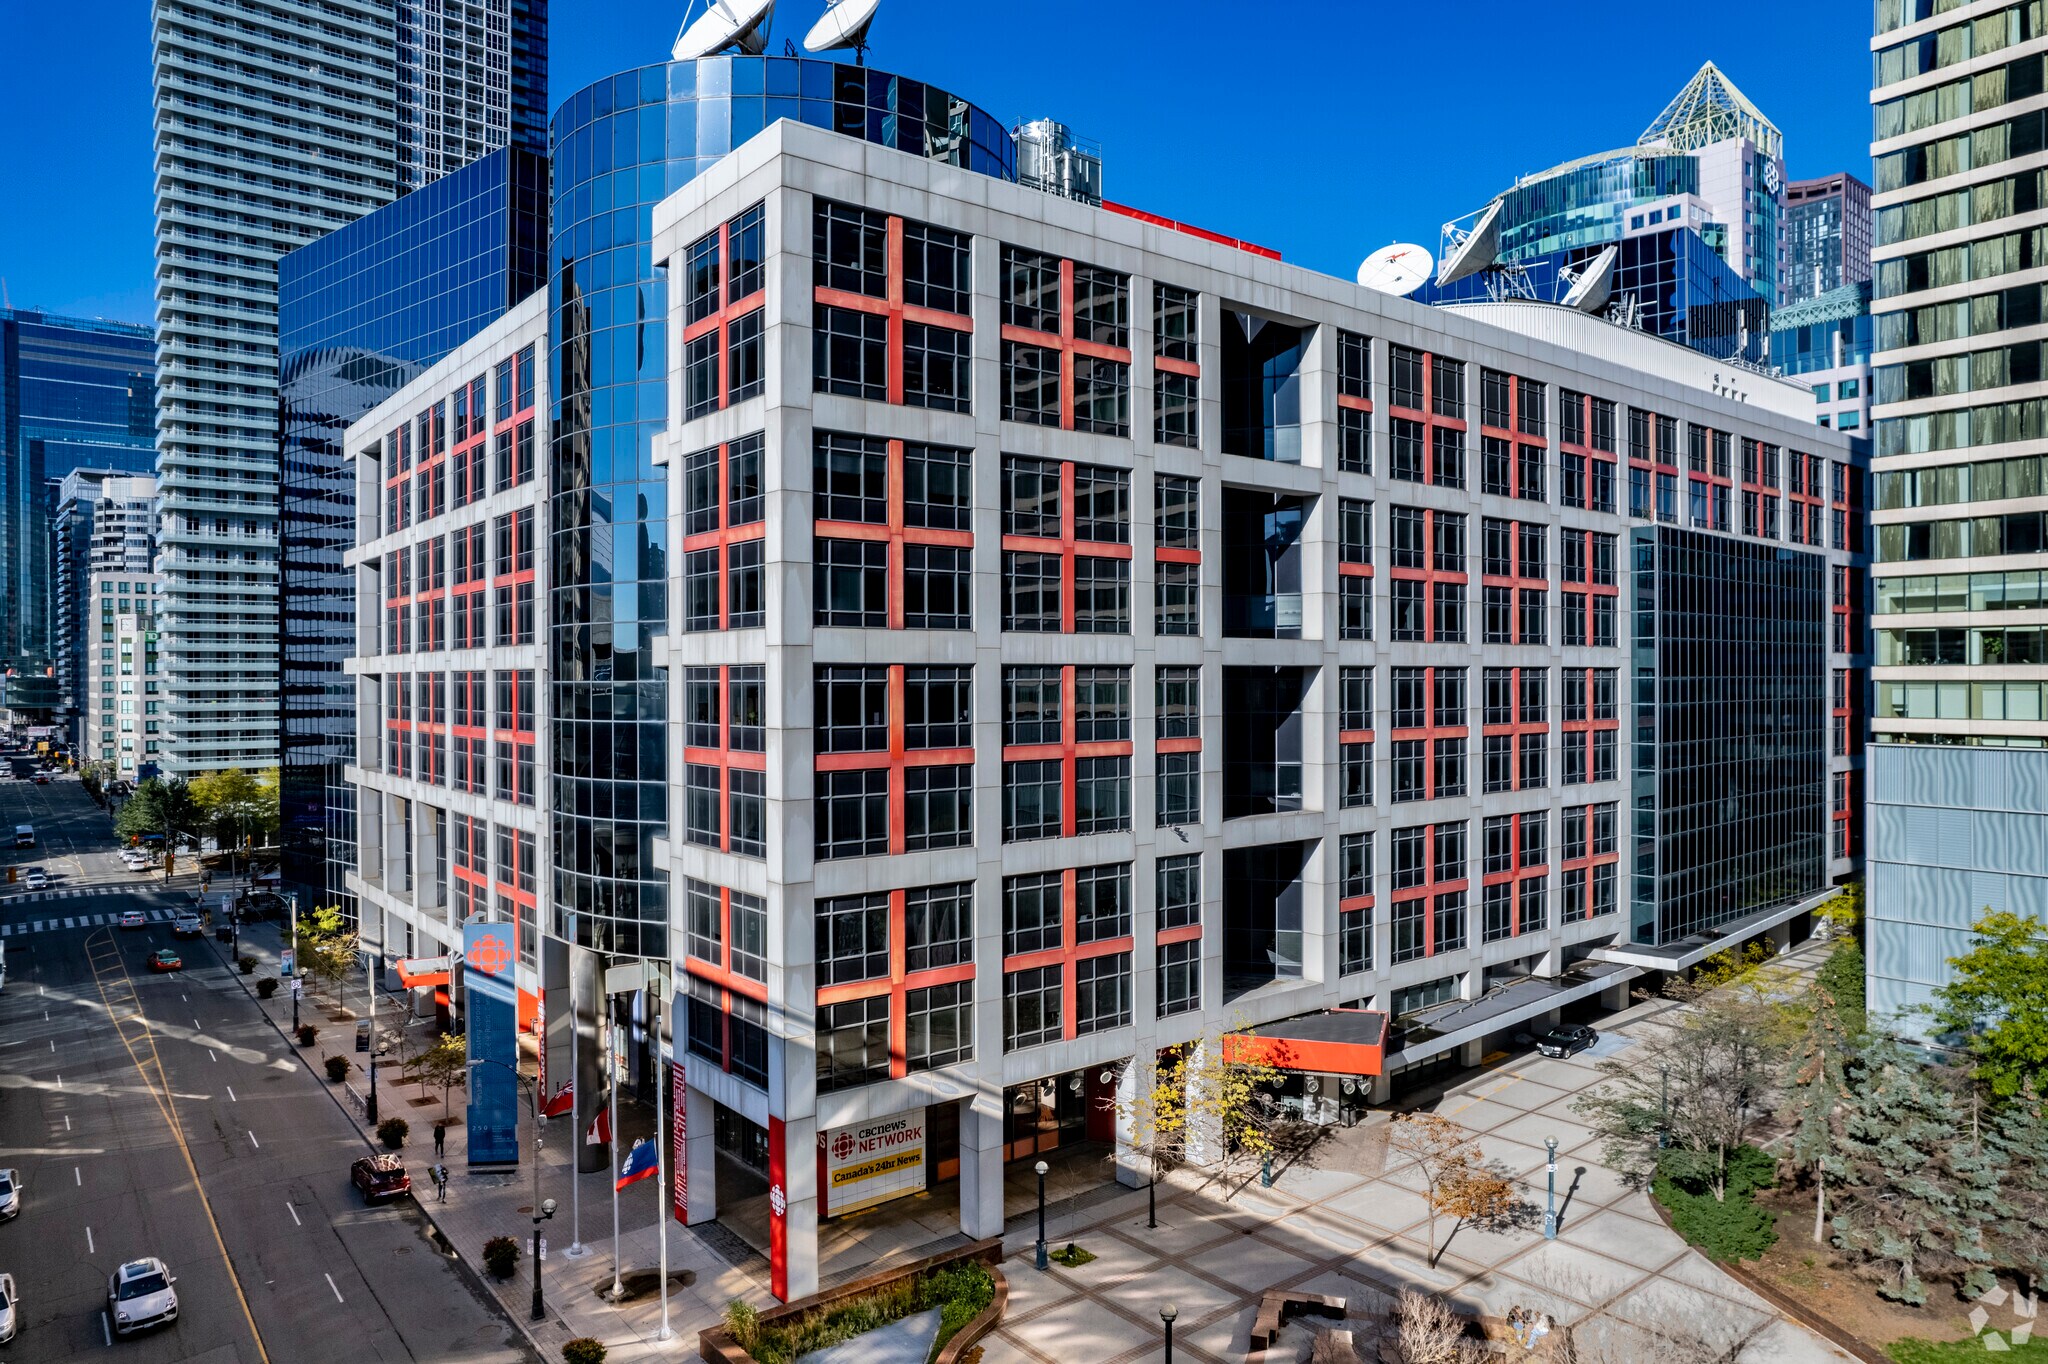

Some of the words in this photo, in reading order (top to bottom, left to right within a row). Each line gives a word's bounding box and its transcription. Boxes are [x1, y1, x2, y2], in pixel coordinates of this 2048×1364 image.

[858, 1127, 922, 1154] NETWORK
[834, 1165, 875, 1183] Canada's
[875, 1160, 895, 1172] 24hr
[896, 1153, 920, 1166] News
